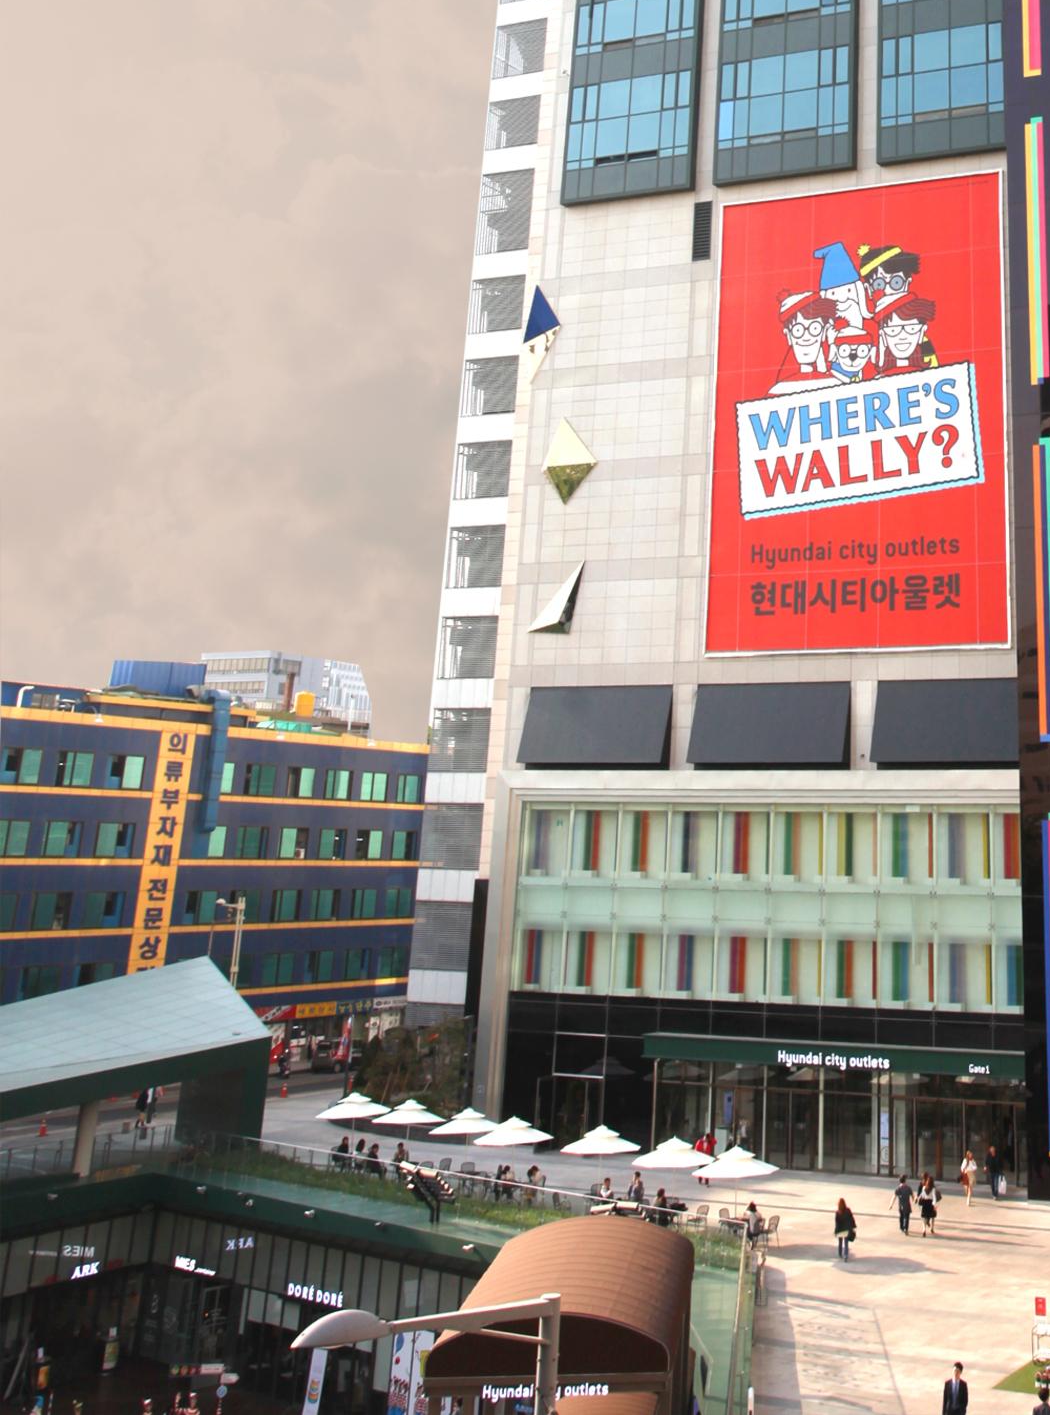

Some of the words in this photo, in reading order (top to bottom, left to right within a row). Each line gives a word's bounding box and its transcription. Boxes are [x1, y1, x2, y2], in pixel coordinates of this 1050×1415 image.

[749, 378, 960, 451] WHERE'S
[754, 424, 960, 498] WALLY?
[751, 541, 832, 570] Hyundai
[839, 540, 878, 565] city
[885, 536, 961, 558] outlets
[750, 573, 961, 616] 현대시티아울렛
[150, 732, 188, 867] 의류부자재
[136, 877, 169, 974] 전문상
[777, 1050, 822, 1067] Hyundai
[824, 1053, 847, 1070] city
[849, 1055, 890, 1069] outlets
[70, 1261, 101, 1280] ARK
[288, 1282, 315, 1301] DORÉ
[315, 1289, 344, 1308] DORÉ
[482, 1383, 534, 1403] Hyundai
[564, 1382, 609, 1397] outlets
